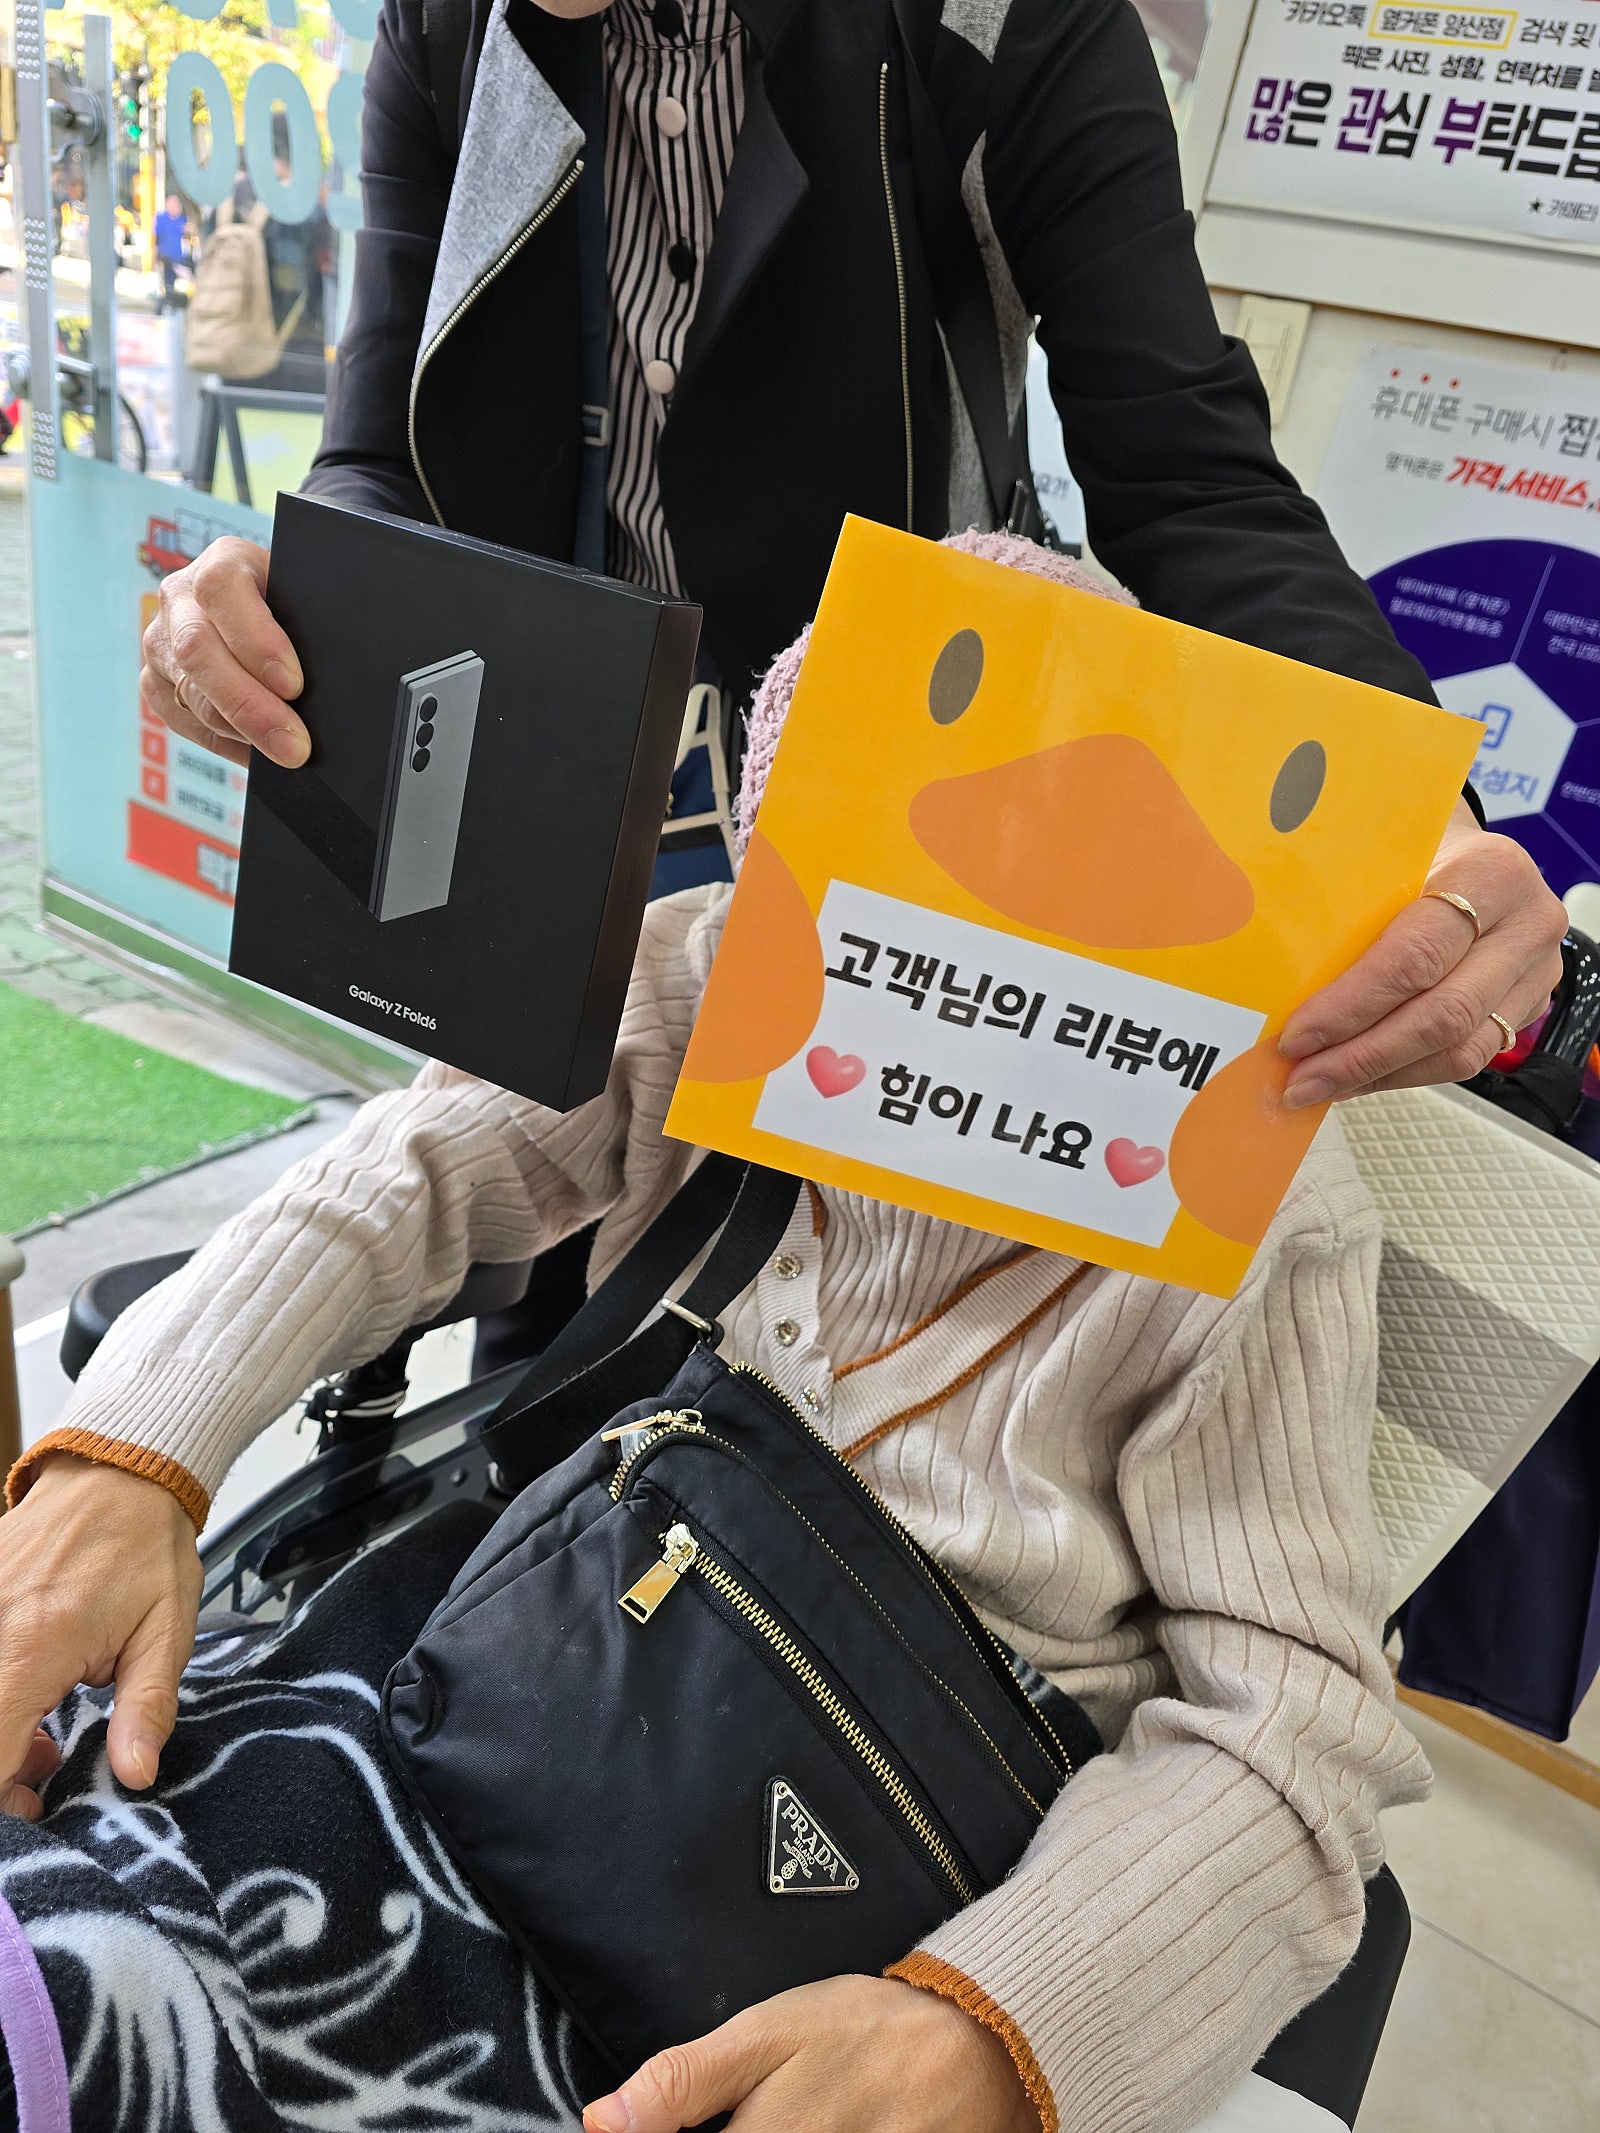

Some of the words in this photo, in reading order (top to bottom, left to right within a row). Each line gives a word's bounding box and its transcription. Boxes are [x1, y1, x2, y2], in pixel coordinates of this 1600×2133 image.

[1442, 13, 1504, 41] 양산점
[1520, 18, 1568, 46] 검색
[1570, 23, 1596, 48] 및
[1495, 59, 1583, 91] 연락처를
[1245, 77, 1332, 148] 많은
[1334, 87, 1431, 159] 관심
[1370, 385, 1462, 433] 휴대폰
[1464, 403, 1554, 449] 구매시
[348, 984, 393, 1015] Galaxy
[393, 1002, 403, 1017] Z
[402, 1006, 437, 1031] Fold6
[824, 931, 1047, 1039] 고객님의
[1053, 1002, 1220, 1092] 리뷰에
[878, 1063, 983, 1136] 힘이
[991, 1103, 1093, 1170] 나요
[781, 1801, 839, 1882] PRADA
[793, 1836, 815, 1865] MILANO
